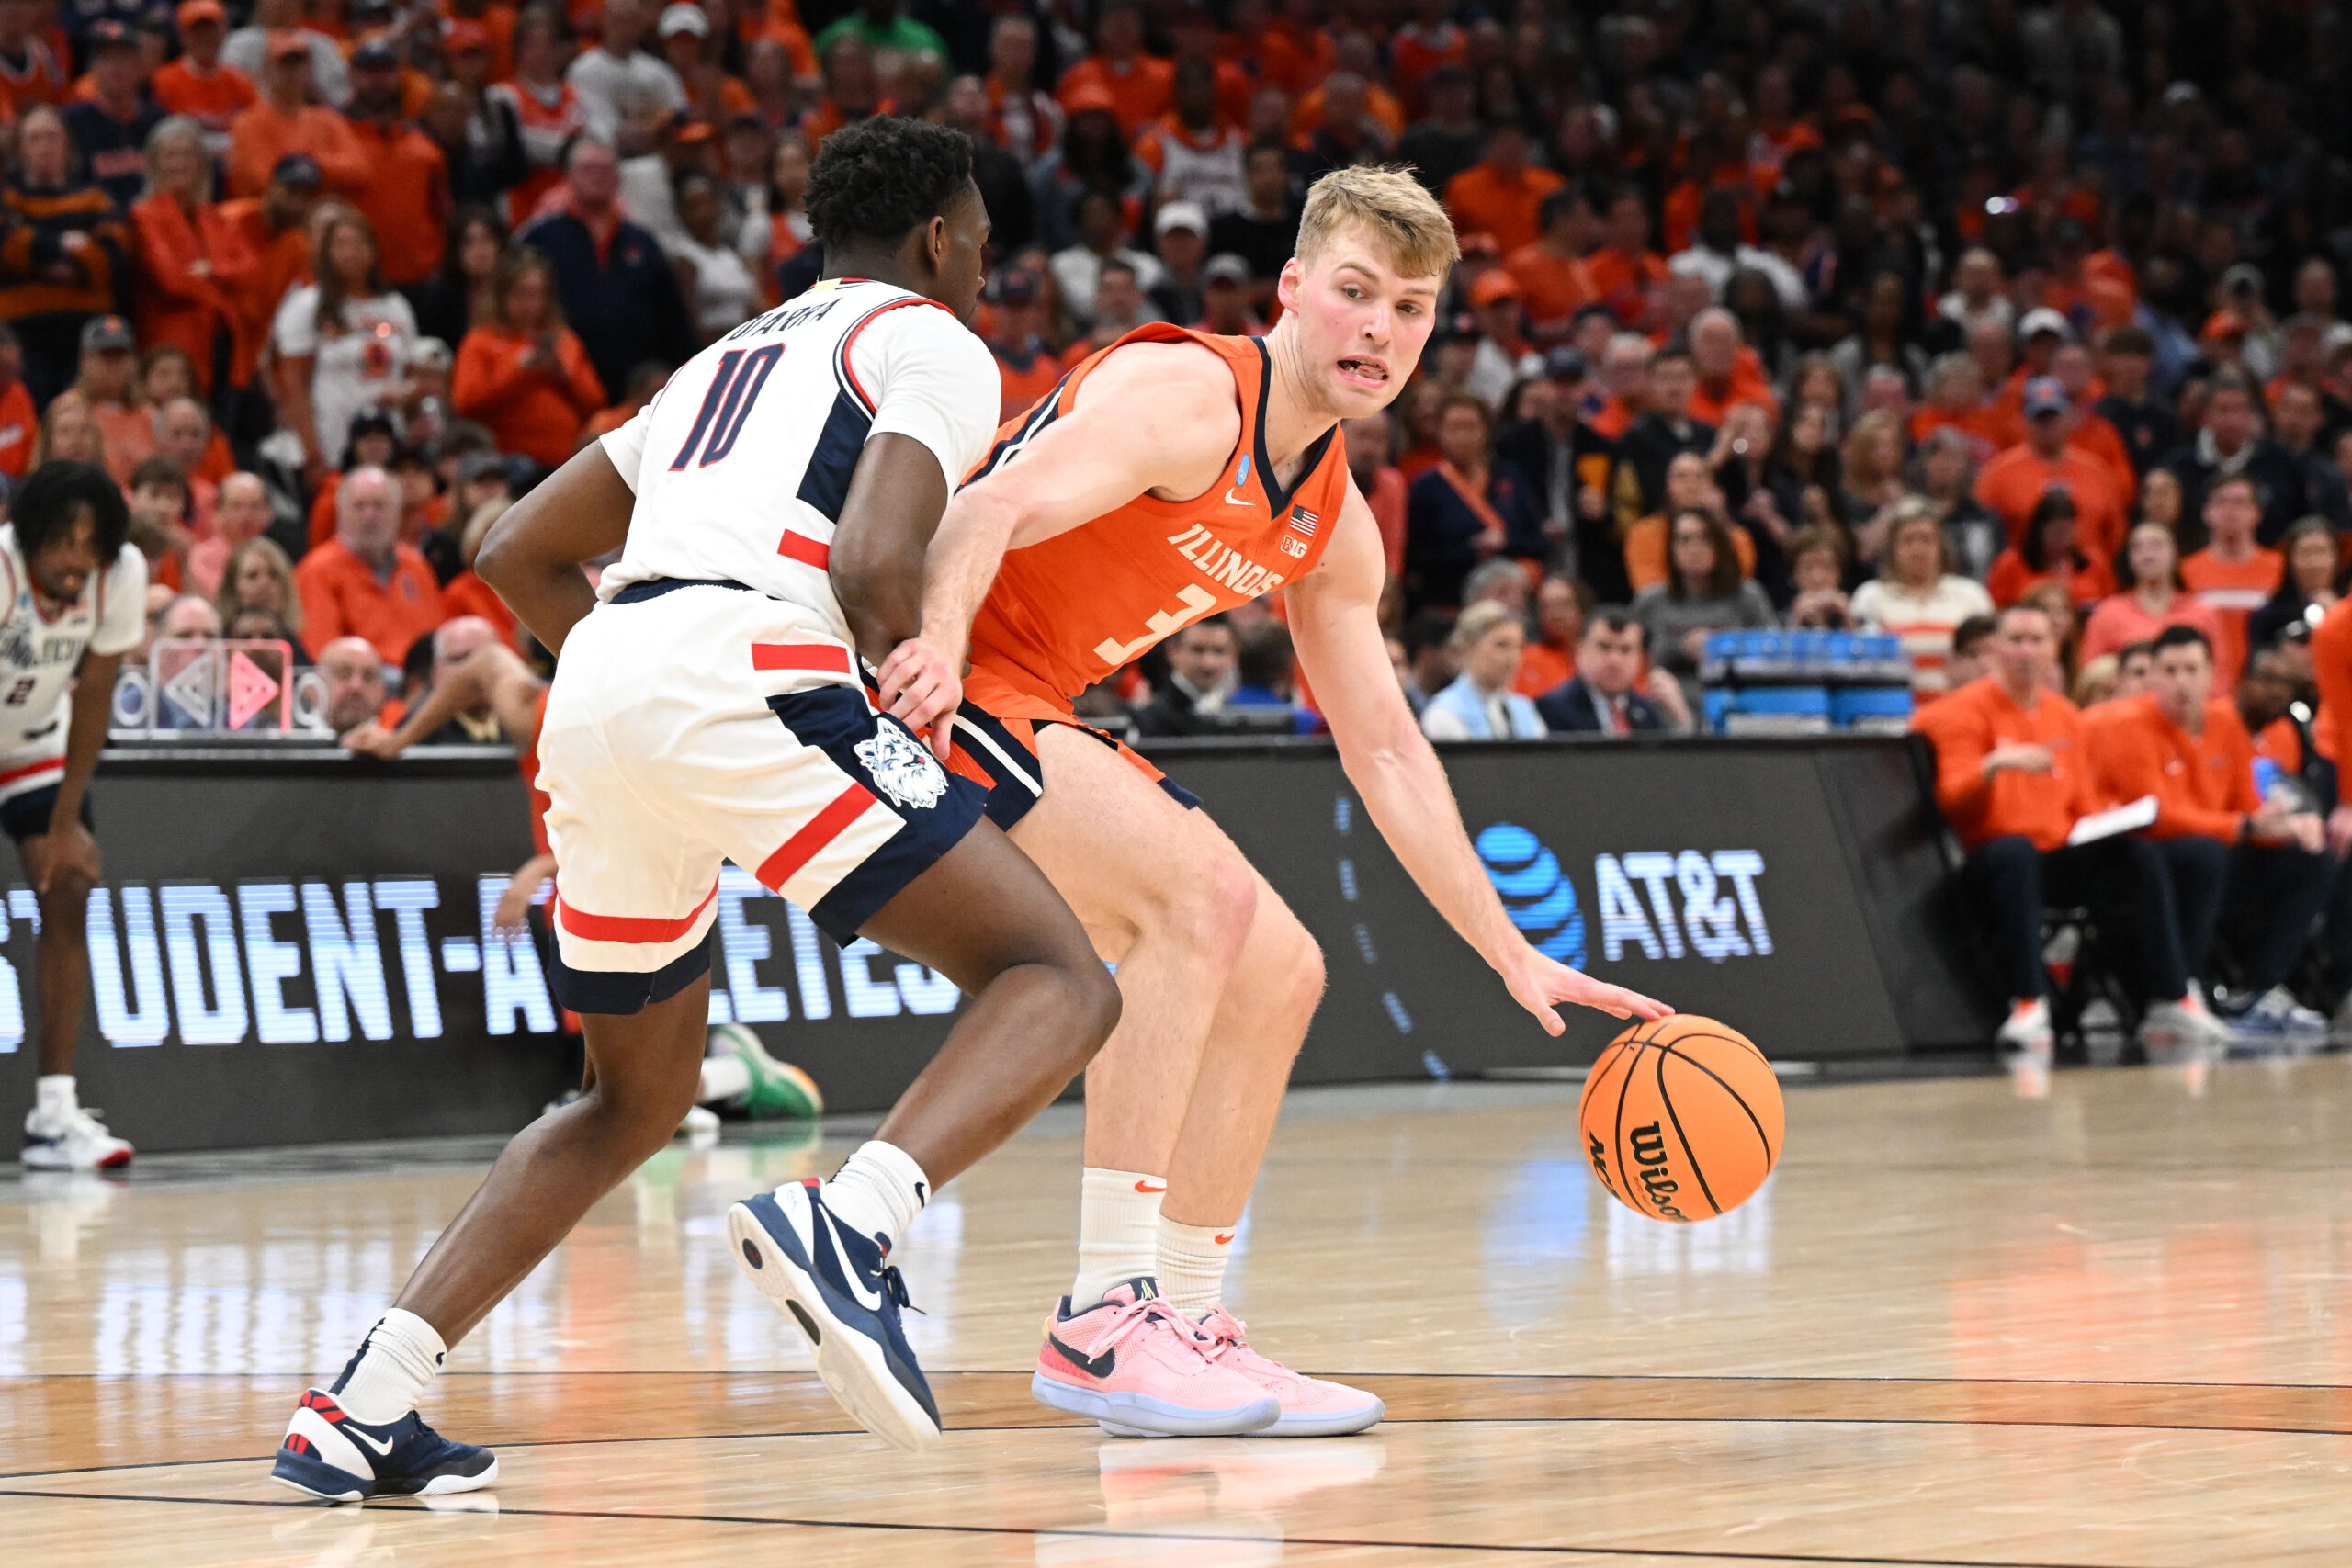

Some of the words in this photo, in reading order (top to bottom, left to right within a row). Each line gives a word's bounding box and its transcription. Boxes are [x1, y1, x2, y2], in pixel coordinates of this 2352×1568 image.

[667, 342, 786, 471] 10
[1167, 523, 1284, 598] ILLINOIS
[1092, 582, 1217, 666] 3
[1594, 849, 1773, 963] AT&T
[1589, 1131, 1622, 1200] NC
